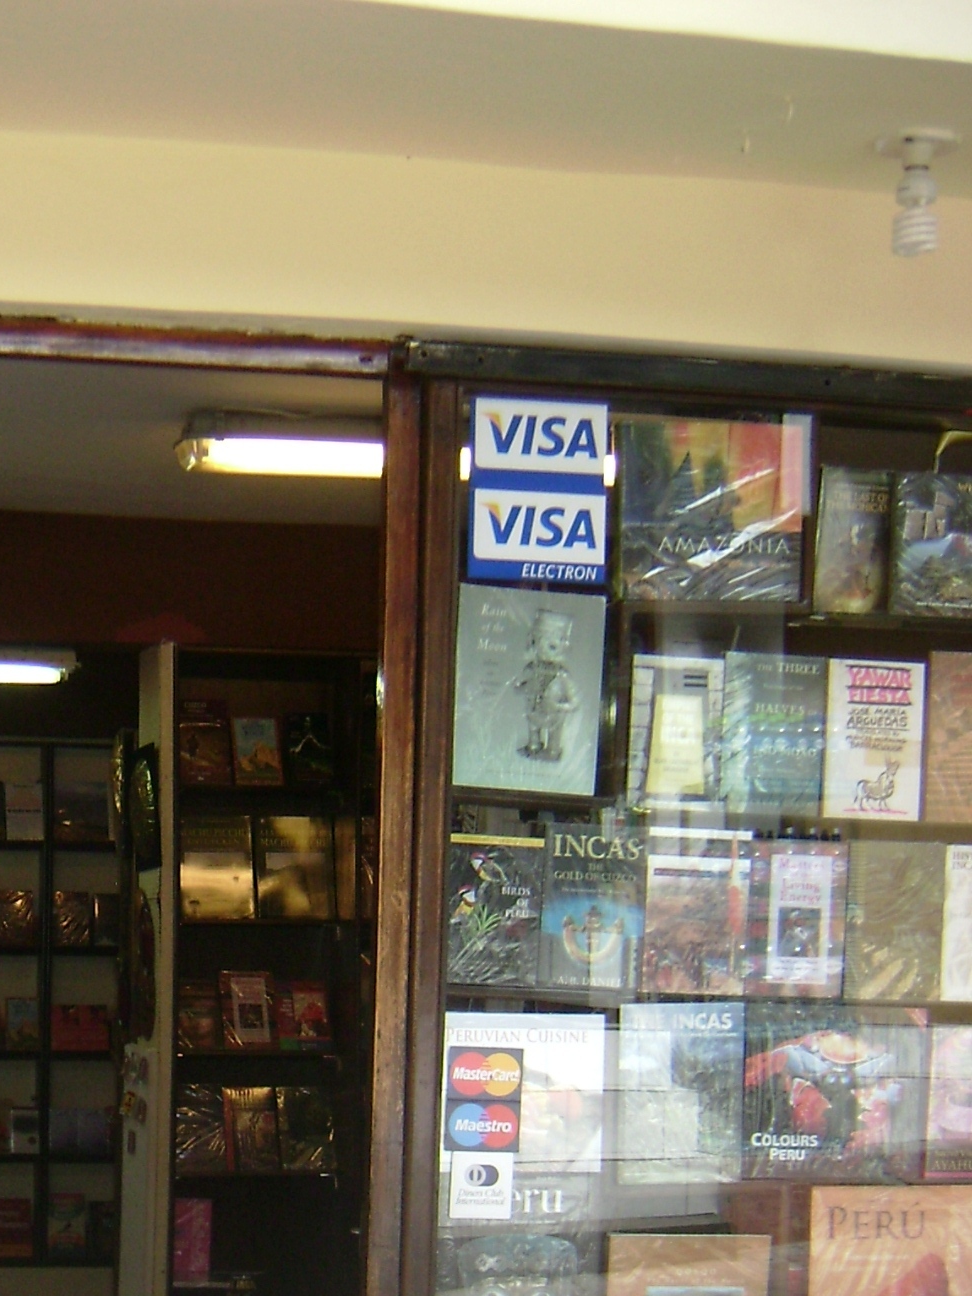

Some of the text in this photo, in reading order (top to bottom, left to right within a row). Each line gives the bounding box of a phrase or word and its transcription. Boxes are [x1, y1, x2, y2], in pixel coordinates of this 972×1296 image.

[482, 412, 598, 459] VISA
[481, 502, 597, 549] VISA
[521, 563, 598, 581] ELECTRON
[481, 602, 507, 617] Rain
[477, 637, 508, 652] Moon
[776, 661, 821, 675] THREE
[850, 668, 912, 688] YAWAR
[850, 688, 912, 704] FIESTA
[847, 716, 908, 728] ARGUEDAS
[553, 833, 640, 860] INCAS
[554, 870, 584, 881] GOLD
[501, 886, 531, 896] BIRDS
[780, 890, 821, 905] Energy
[673, 1012, 733, 1030] INCAS
[446, 1028, 589, 1044] PERUVIAN CUISINE
[452, 1066, 520, 1082] MasterCard
[454, 1119, 512, 1133] Maestro
[751, 1131, 819, 1147] COLOURS
[769, 1148, 805, 1161] PERU
[487, 1187, 505, 1199] Club
[455, 1196, 505, 1206] International
[828, 1202, 926, 1240] PERÚ
